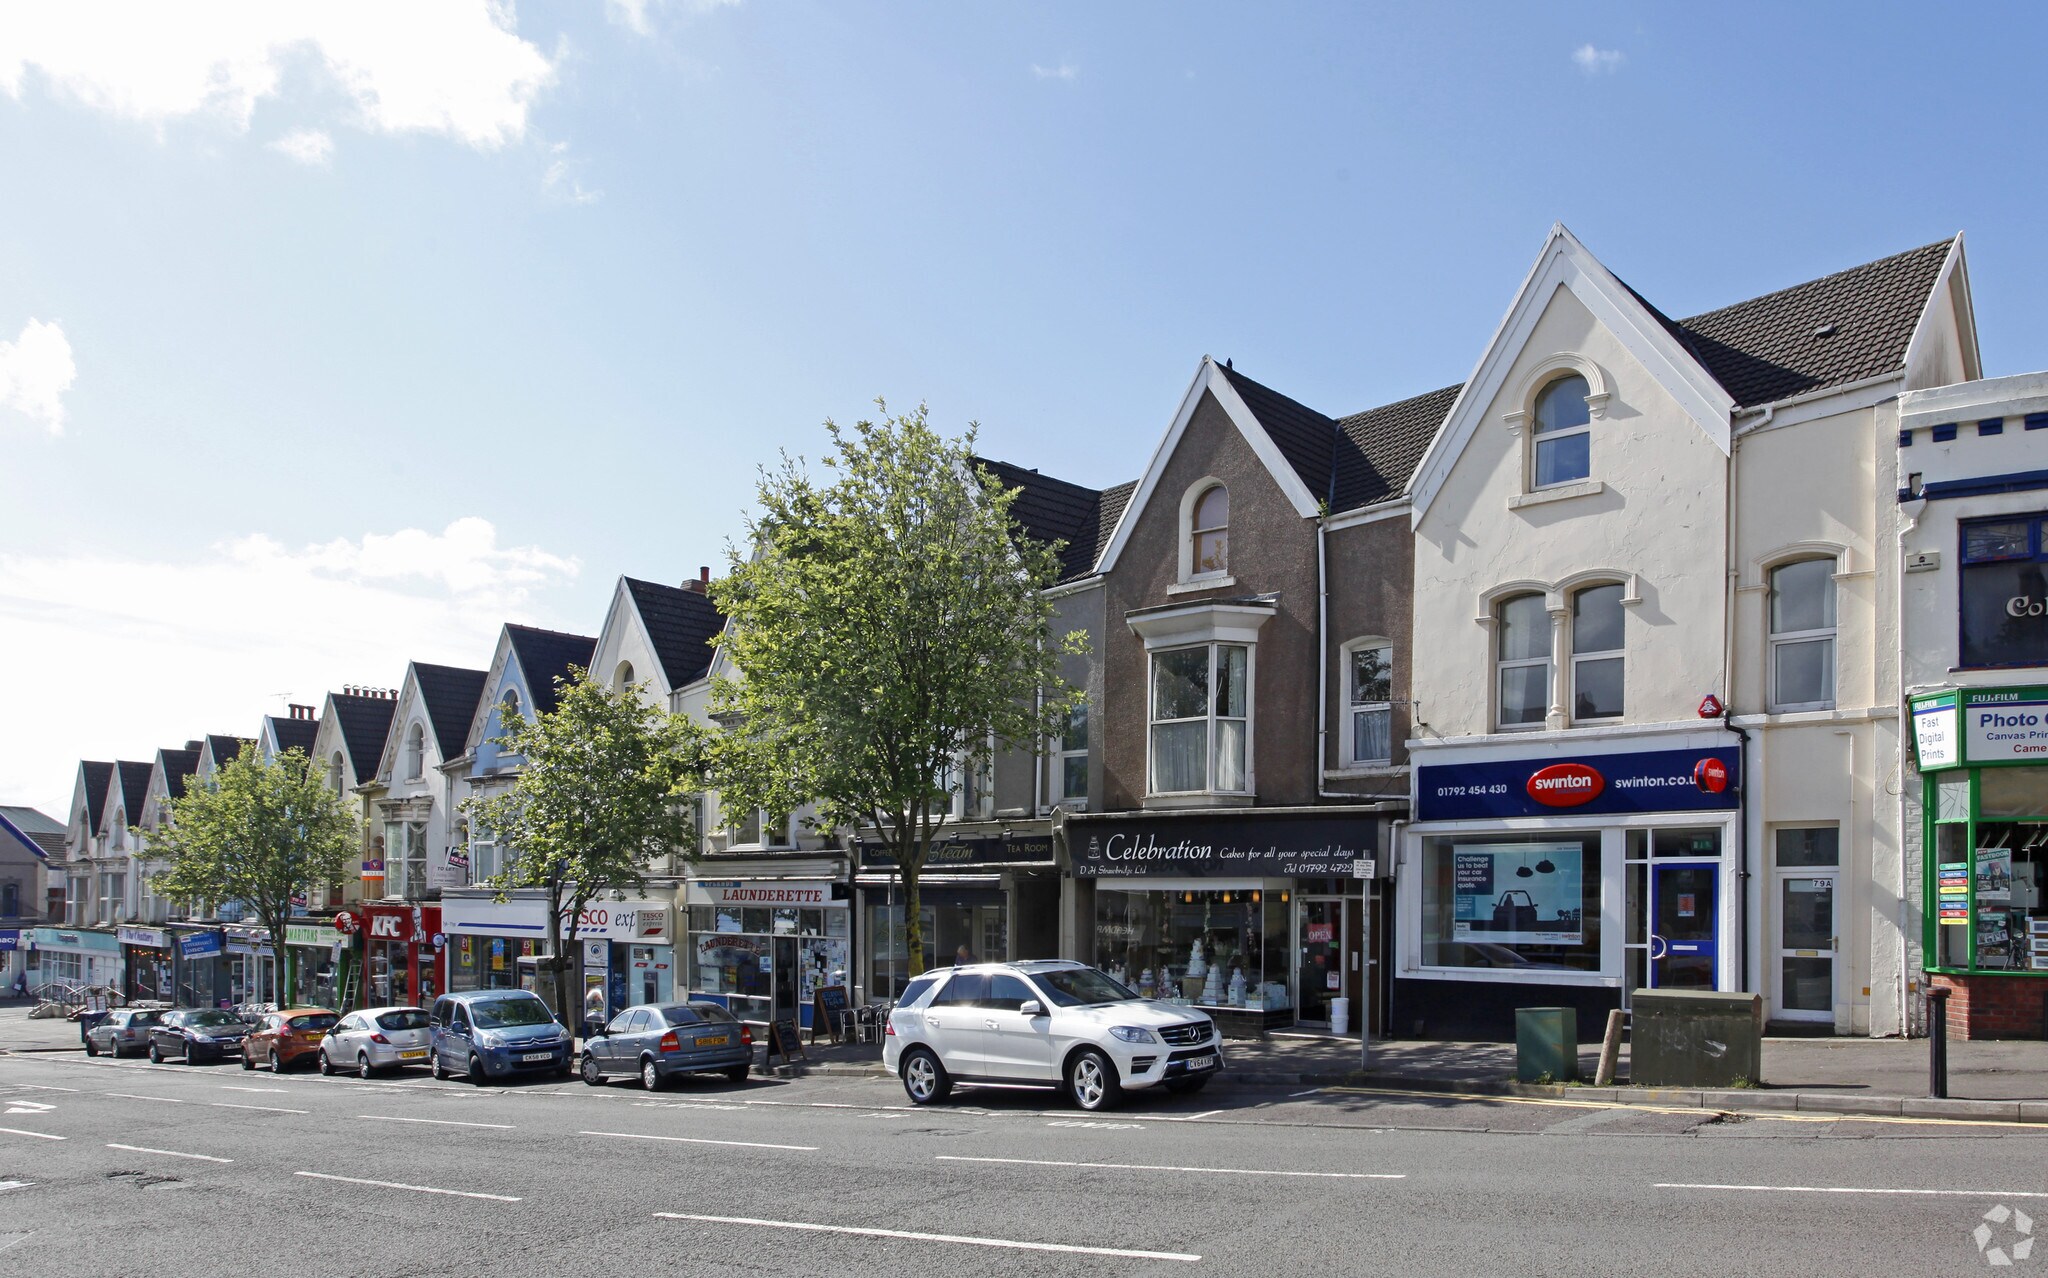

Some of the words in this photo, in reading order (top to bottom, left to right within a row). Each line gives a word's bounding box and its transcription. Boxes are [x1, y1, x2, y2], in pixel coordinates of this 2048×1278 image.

[2006, 596, 2048, 617] Co
[1972, 693, 2018, 702] FUJIFILM
[1921, 717, 1939, 728] Fast
[1980, 713, 2038, 728] Photo
[1919, 731, 1945, 746] Digital
[1986, 732, 2026, 740] Canvas
[1921, 750, 1945, 760] Prints
[1708, 766, 1725, 778] swinton
[1535, 774, 1592, 790] swinton
[1615, 775, 1697, 789] swinton.co.u
[1437, 786, 1466, 797] 01792
[1468, 785, 1487, 795] 454
[1489, 784, 1508, 794] 430
[928, 841, 973, 863] Steam
[1106, 833, 1212, 860] Celebration
[1219, 847, 1245, 859] Cakes
[1248, 847, 1261, 861] for
[1264, 846, 1276, 858] all
[1278, 850, 1297, 861] your
[1300, 845, 1331, 860] special
[1333, 845, 1354, 860] days
[1457, 856, 1489, 864] Challenge
[1079, 865, 1087, 874] D
[1134, 865, 1147, 874] Ltd
[1283, 863, 1296, 873] Tel
[1299, 864, 1327, 874] 01792
[722, 889, 823, 902] LAUNDERETTE
[563, 909, 608, 925] TSCO
[370, 915, 402, 937] KFC
[1308, 930, 1333, 940] OPEN
[699, 936, 762, 957] LAUNDERETTE
